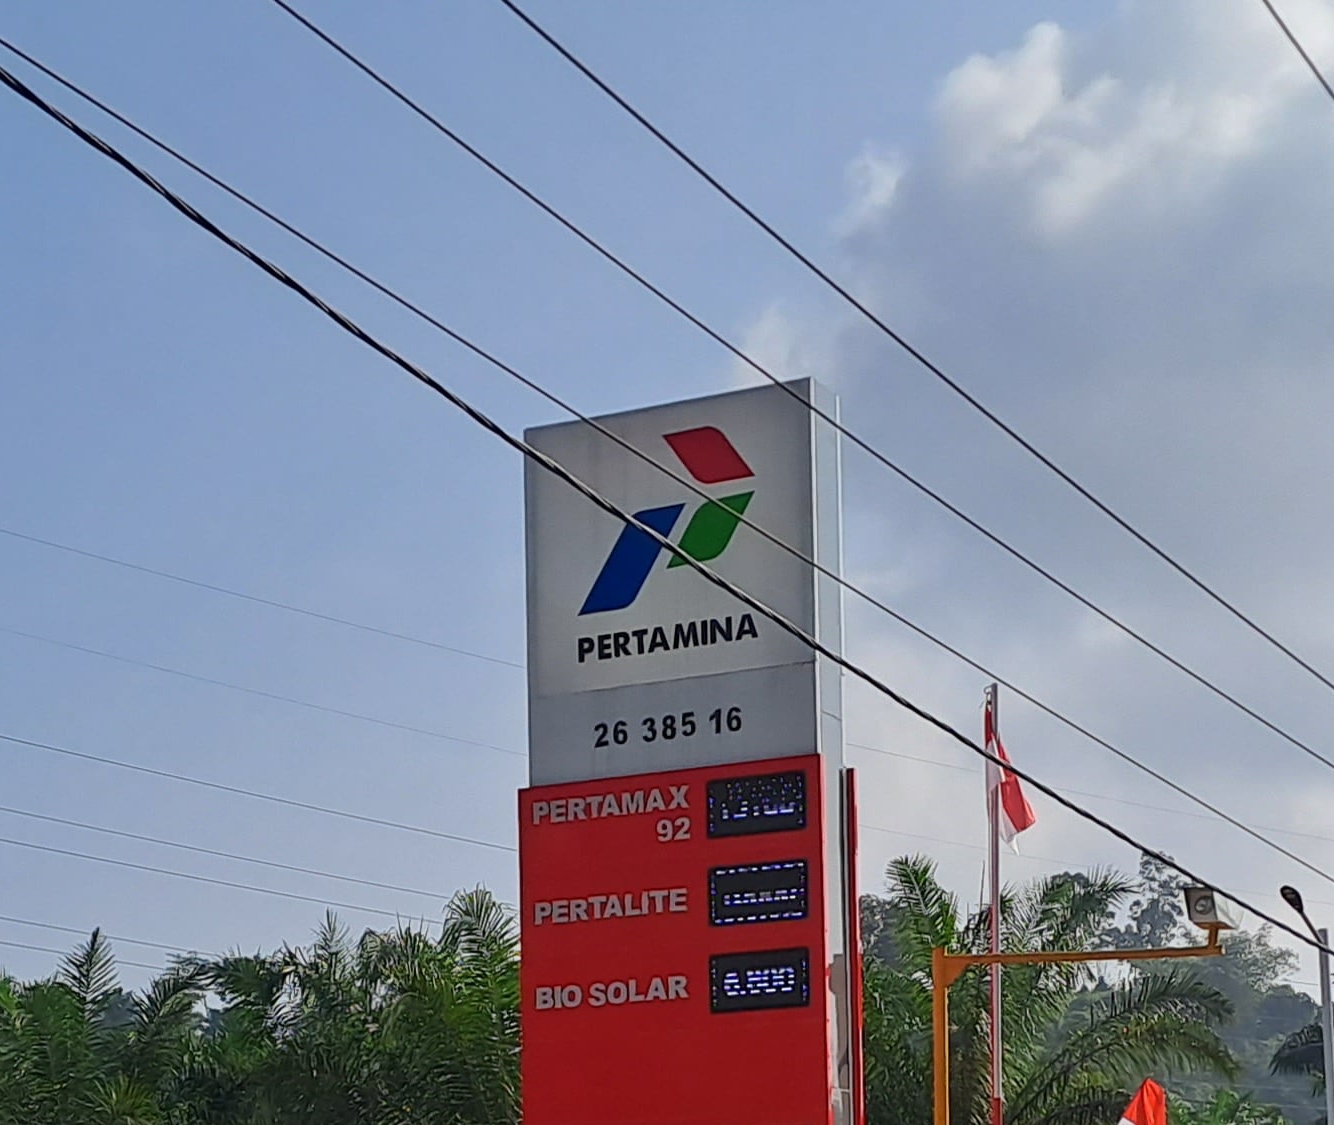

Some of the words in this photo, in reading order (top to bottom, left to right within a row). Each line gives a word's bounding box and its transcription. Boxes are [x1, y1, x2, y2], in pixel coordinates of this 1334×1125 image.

[577, 613, 759, 664] PERTAMINA
[594, 720, 629, 749] 26
[641, 711, 697, 743] 385
[709, 706, 742, 735] 16
[532, 784, 690, 826] PERTAMAX
[656, 816, 691, 843] 92
[534, 887, 688, 926] PERTALITE
[535, 984, 583, 1010] BIO
[587, 975, 689, 1007] SOLAR
